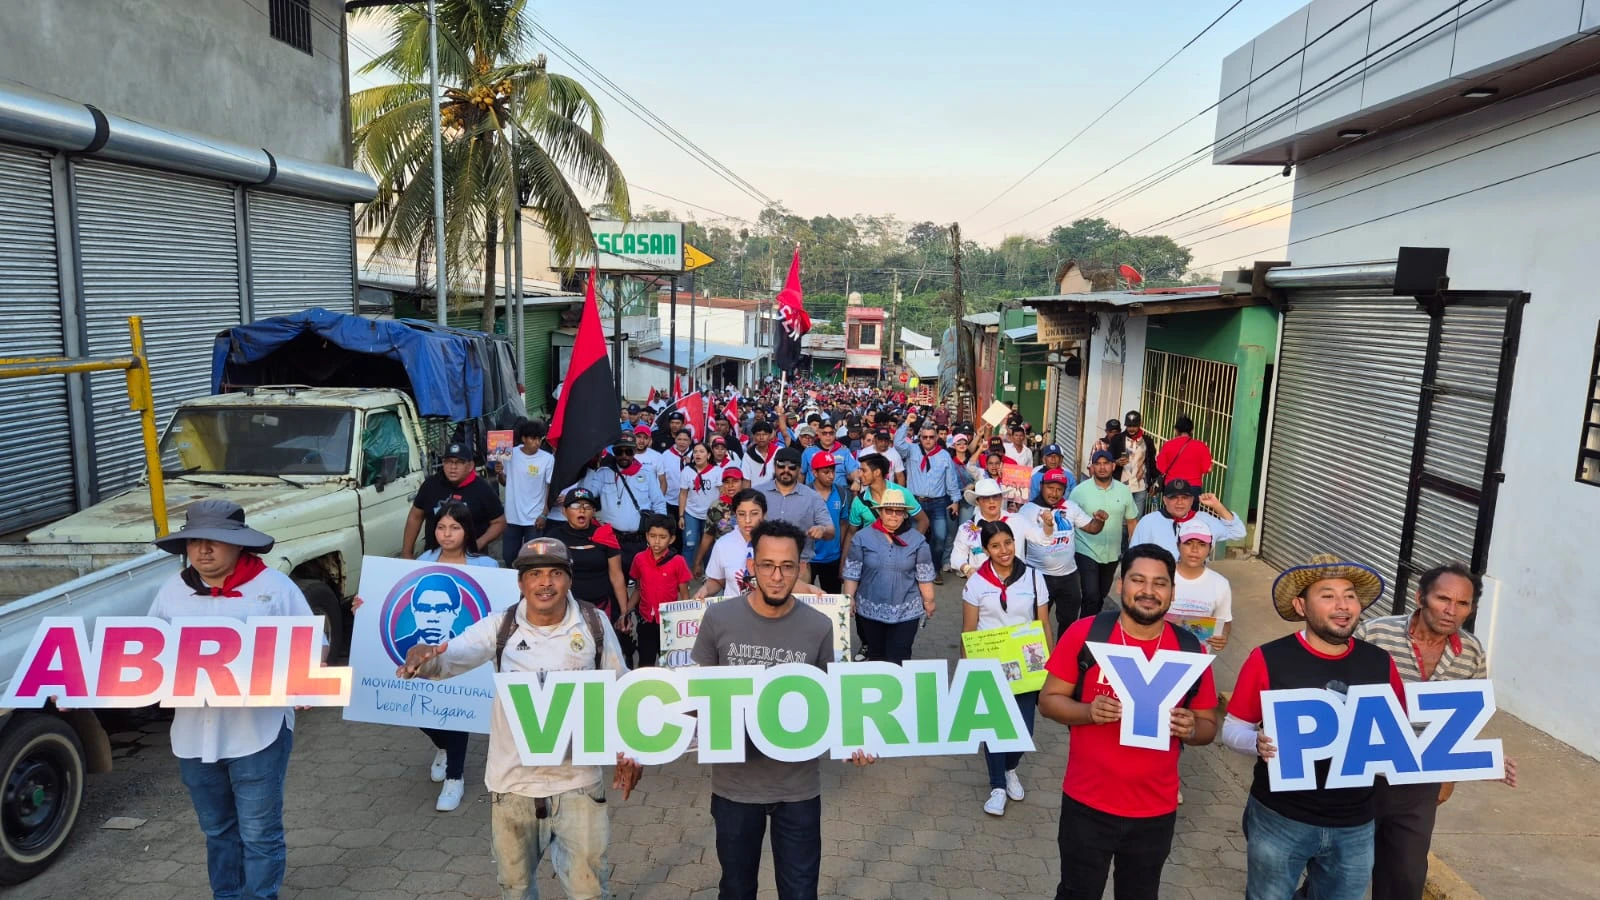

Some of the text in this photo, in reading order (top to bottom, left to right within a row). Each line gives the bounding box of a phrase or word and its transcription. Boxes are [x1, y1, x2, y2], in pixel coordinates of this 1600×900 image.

[15, 626, 341, 697] ABRIL
[361, 676, 494, 699] MOVIMIENTO CULTURAL
[727, 642, 807, 664] AMERICAN
[375, 690, 416, 717] Leonel
[508, 670, 1018, 754] VICTORIA
[1107, 655, 1192, 738] Y
[1273, 690, 1494, 780] PAZ
